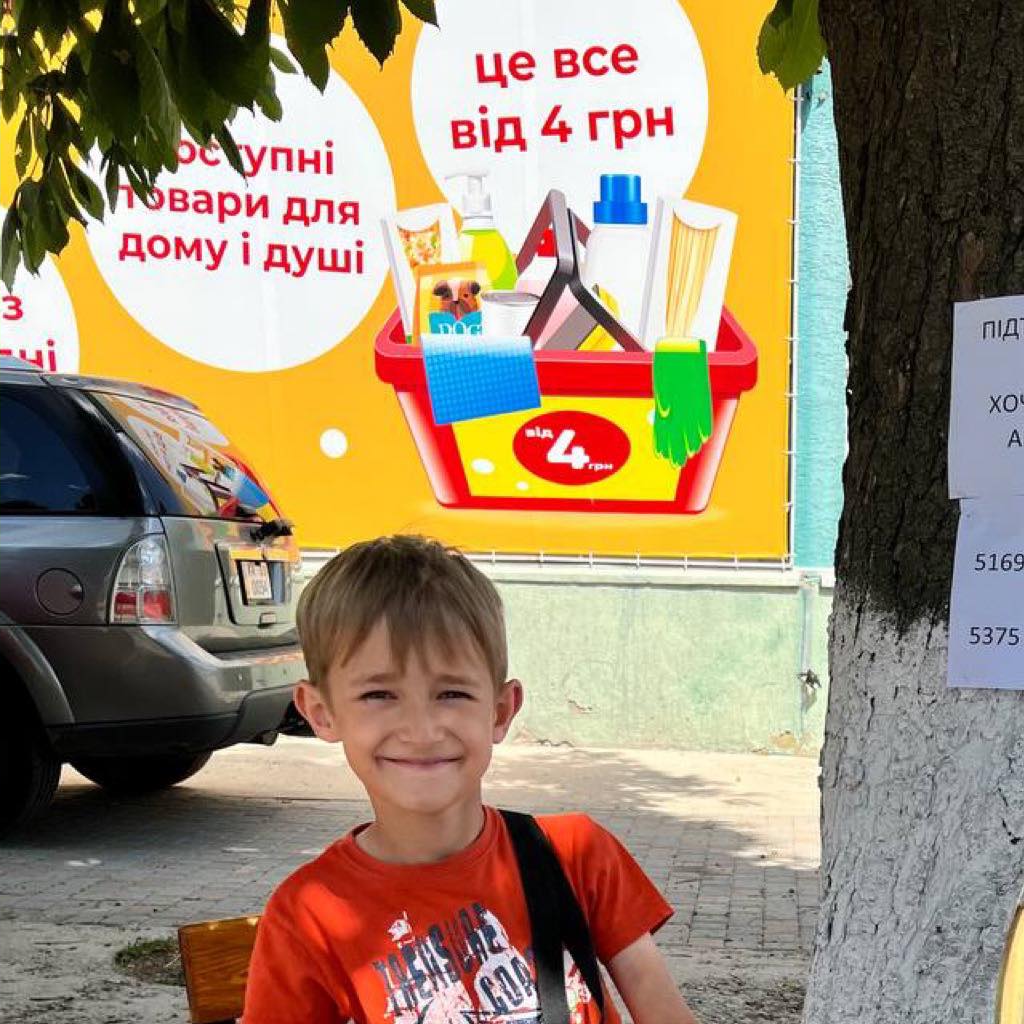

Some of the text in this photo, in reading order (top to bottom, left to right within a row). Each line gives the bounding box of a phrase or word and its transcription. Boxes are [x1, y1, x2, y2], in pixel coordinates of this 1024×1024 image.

[475, 43, 639, 88] це все
[451, 104, 674, 153] від 4 грн
[282, 196, 360, 227] для
[119, 230, 364, 277] дому і душі
[524, 426, 554, 440] від
[546, 429, 590, 470] 4
[974, 553, 1024, 572] 5169
[969, 626, 1020, 646] 5375
